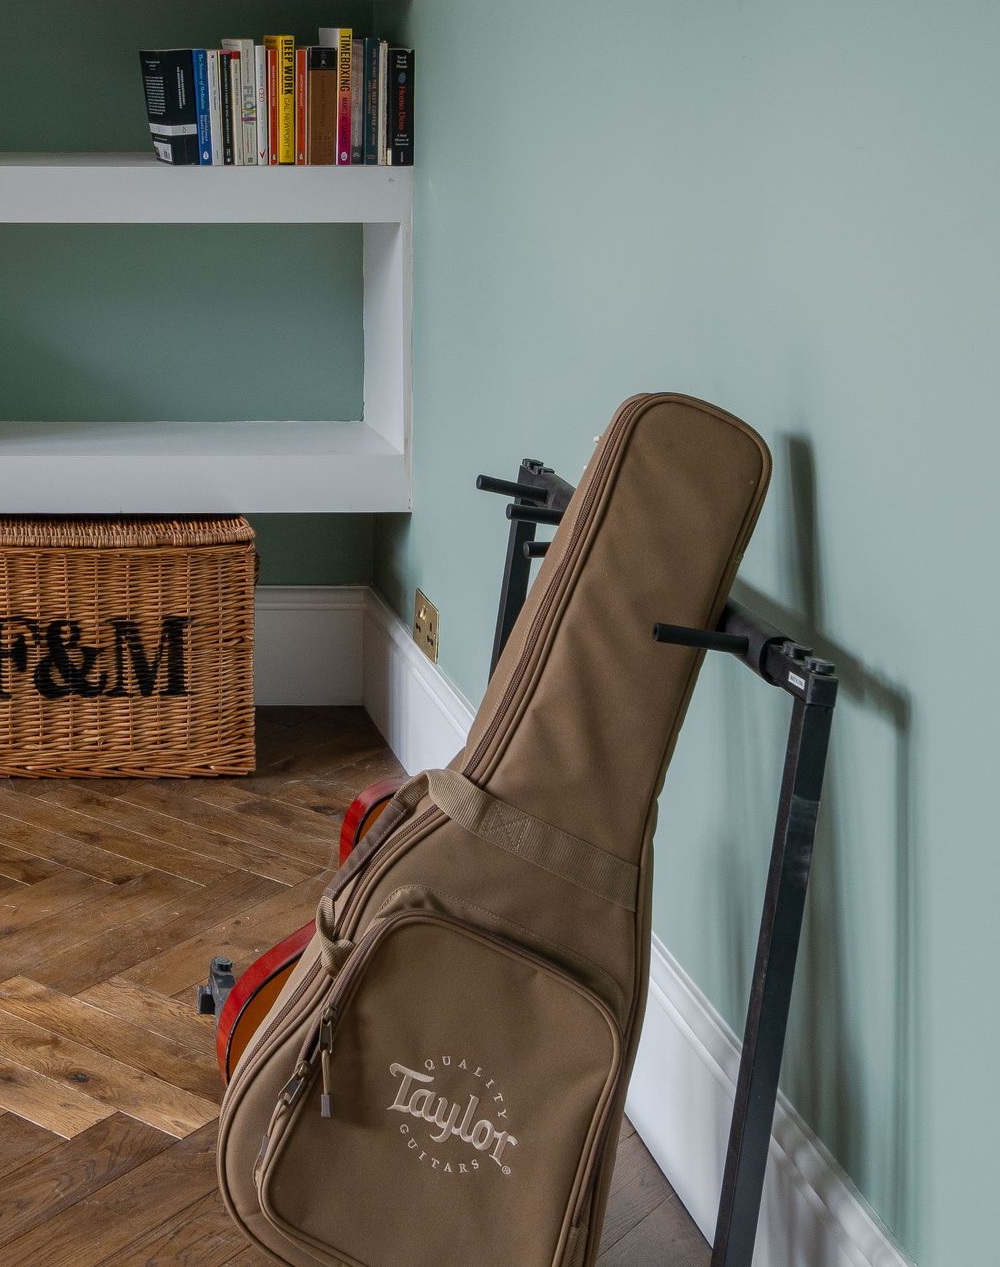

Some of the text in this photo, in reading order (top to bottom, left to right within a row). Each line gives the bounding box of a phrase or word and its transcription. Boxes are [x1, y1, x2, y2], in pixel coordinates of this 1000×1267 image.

[284, 39, 293, 63] DEEP
[340, 34, 351, 92] TIMEBOXING
[283, 97, 291, 111] CAL
[284, 65, 293, 95] WORK
[424, 1055, 508, 1119] QUALITY
[386, 1062, 519, 1167] Taylor
[399, 1123, 480, 1174] GUITARS
